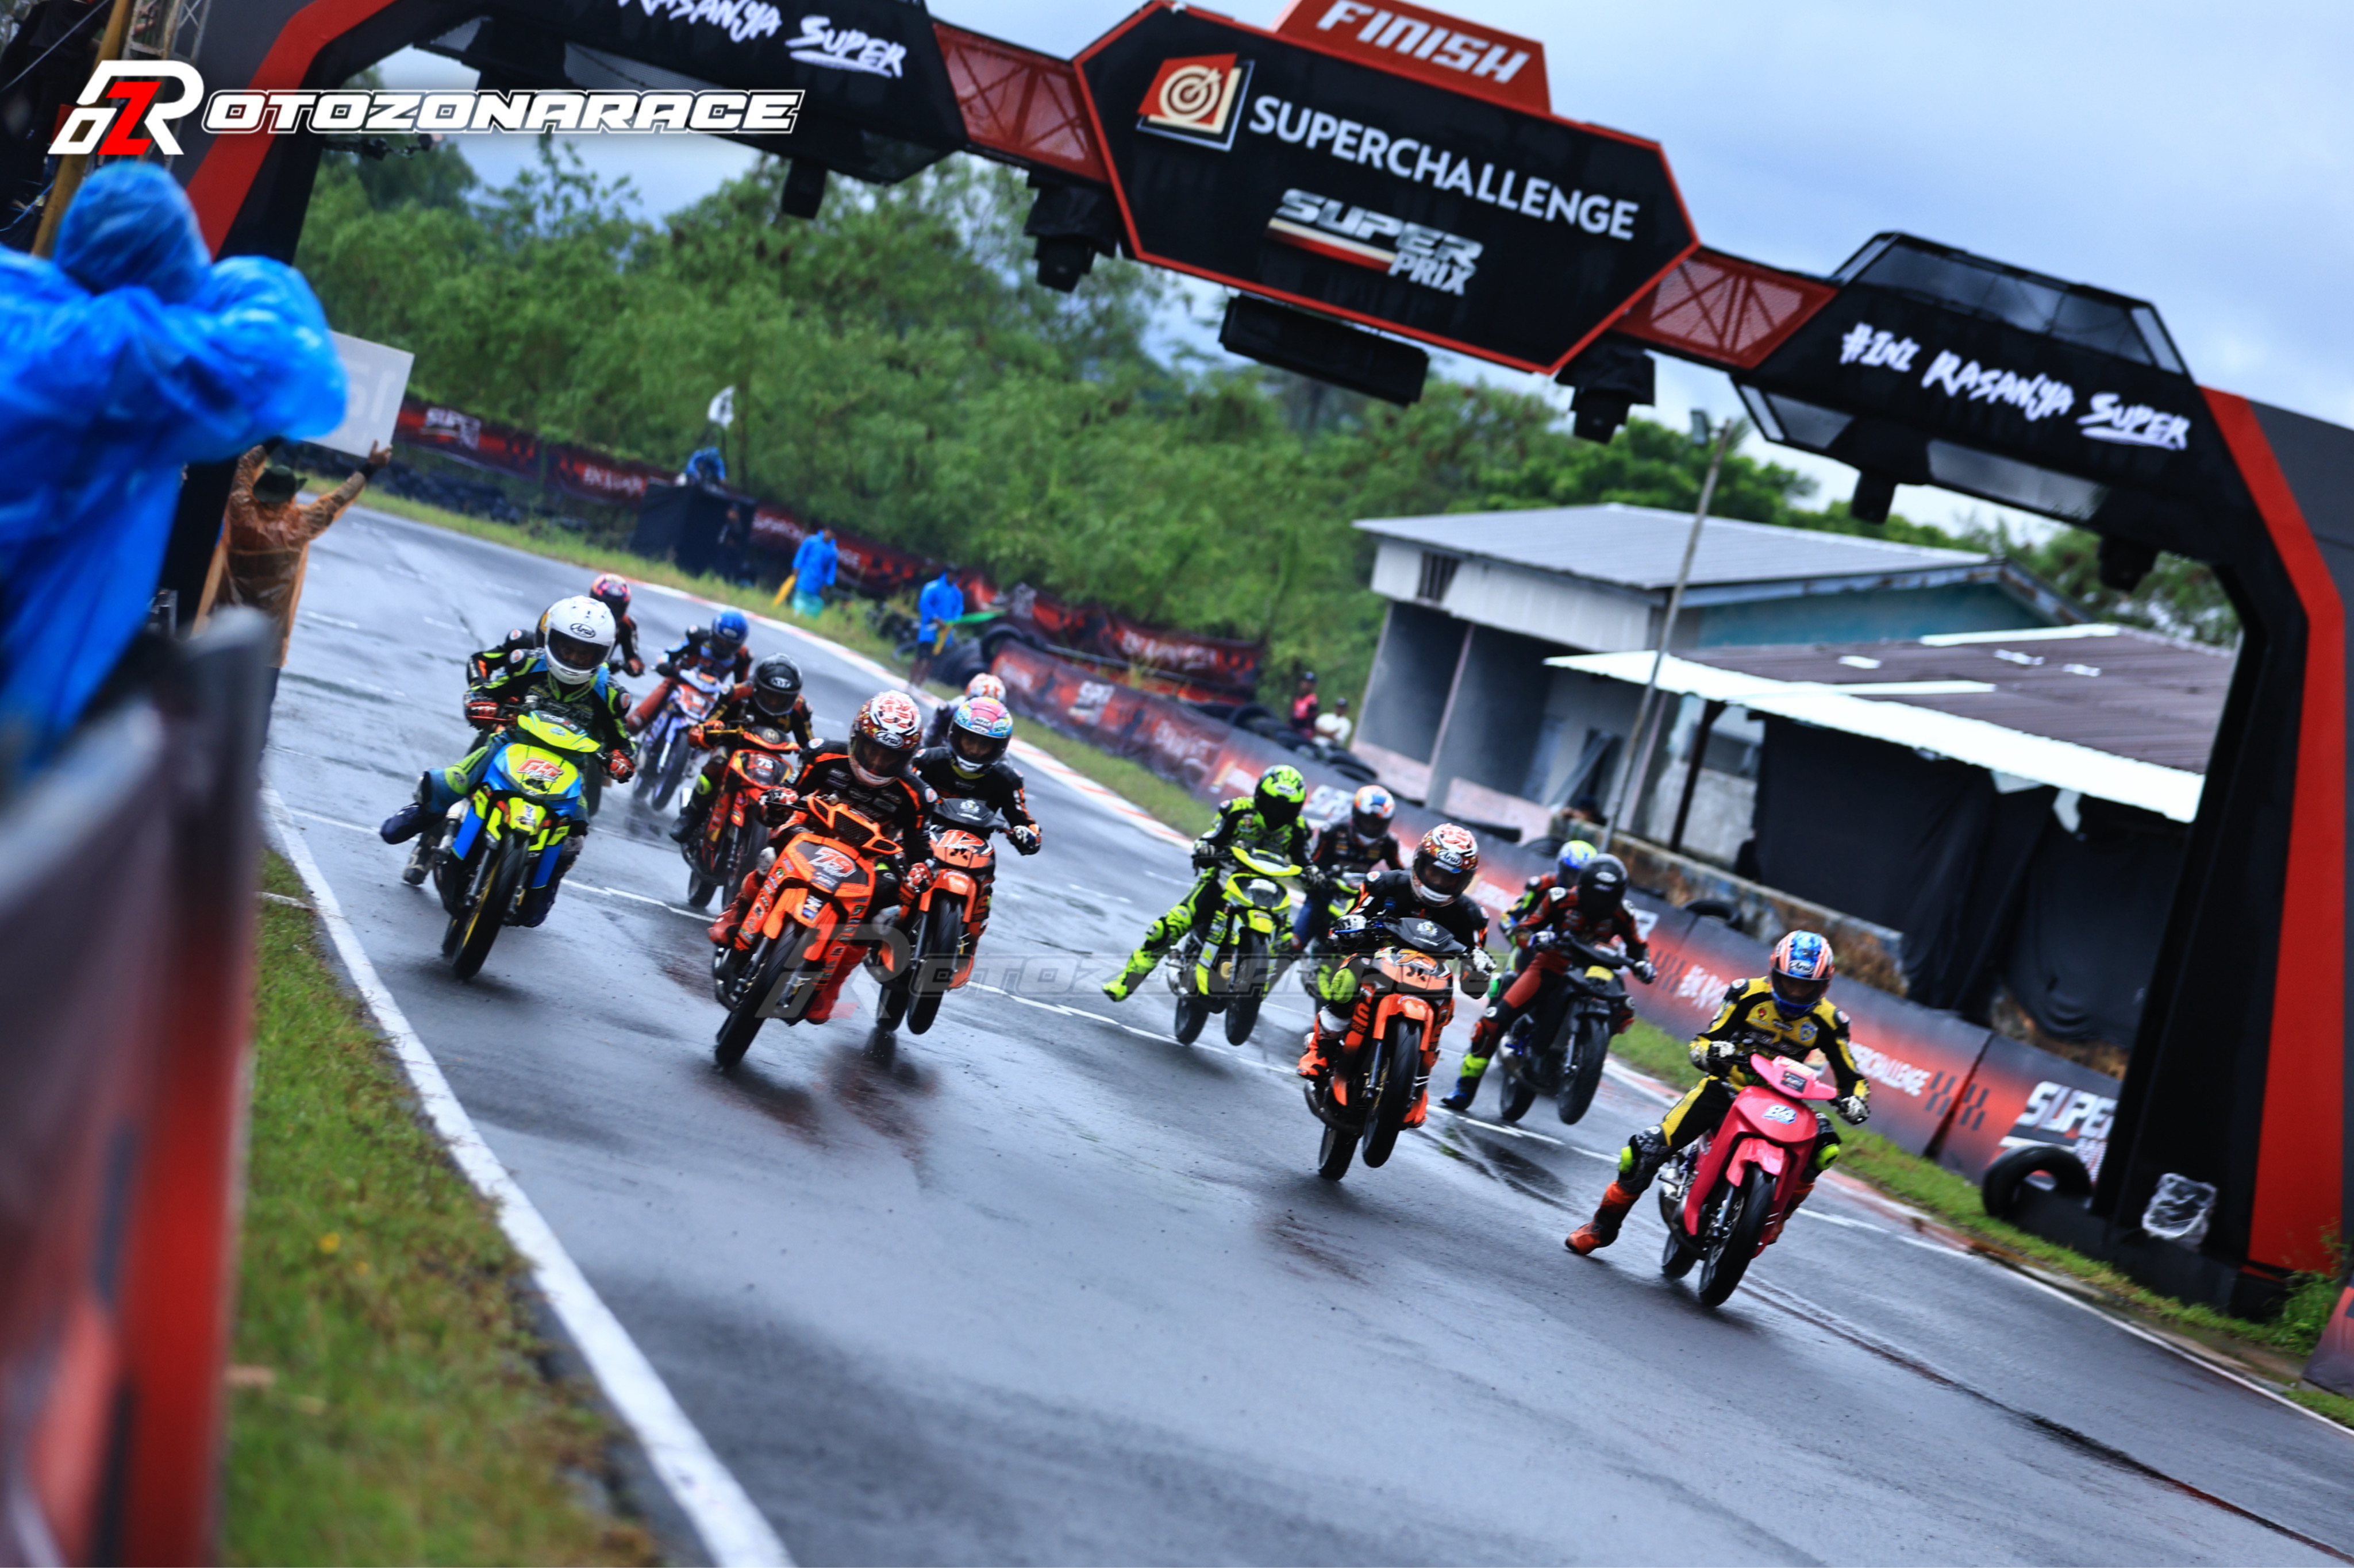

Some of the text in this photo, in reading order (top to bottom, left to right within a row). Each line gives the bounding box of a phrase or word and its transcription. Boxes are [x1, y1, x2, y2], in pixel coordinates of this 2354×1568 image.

[785, 15, 906, 78] SUPER
[1316, 0, 1530, 83] FINISH
[1249, 95, 1640, 241] SUPERCHALLENGE
[1275, 188, 1483, 269] SUPER
[1387, 250, 1476, 296] PRIX
[2076, 392, 2191, 450] SUPER
[876, 731, 903, 747] Arai
[1438, 851, 1462, 866] Arai
[2014, 1080, 2119, 1142] SUPE
